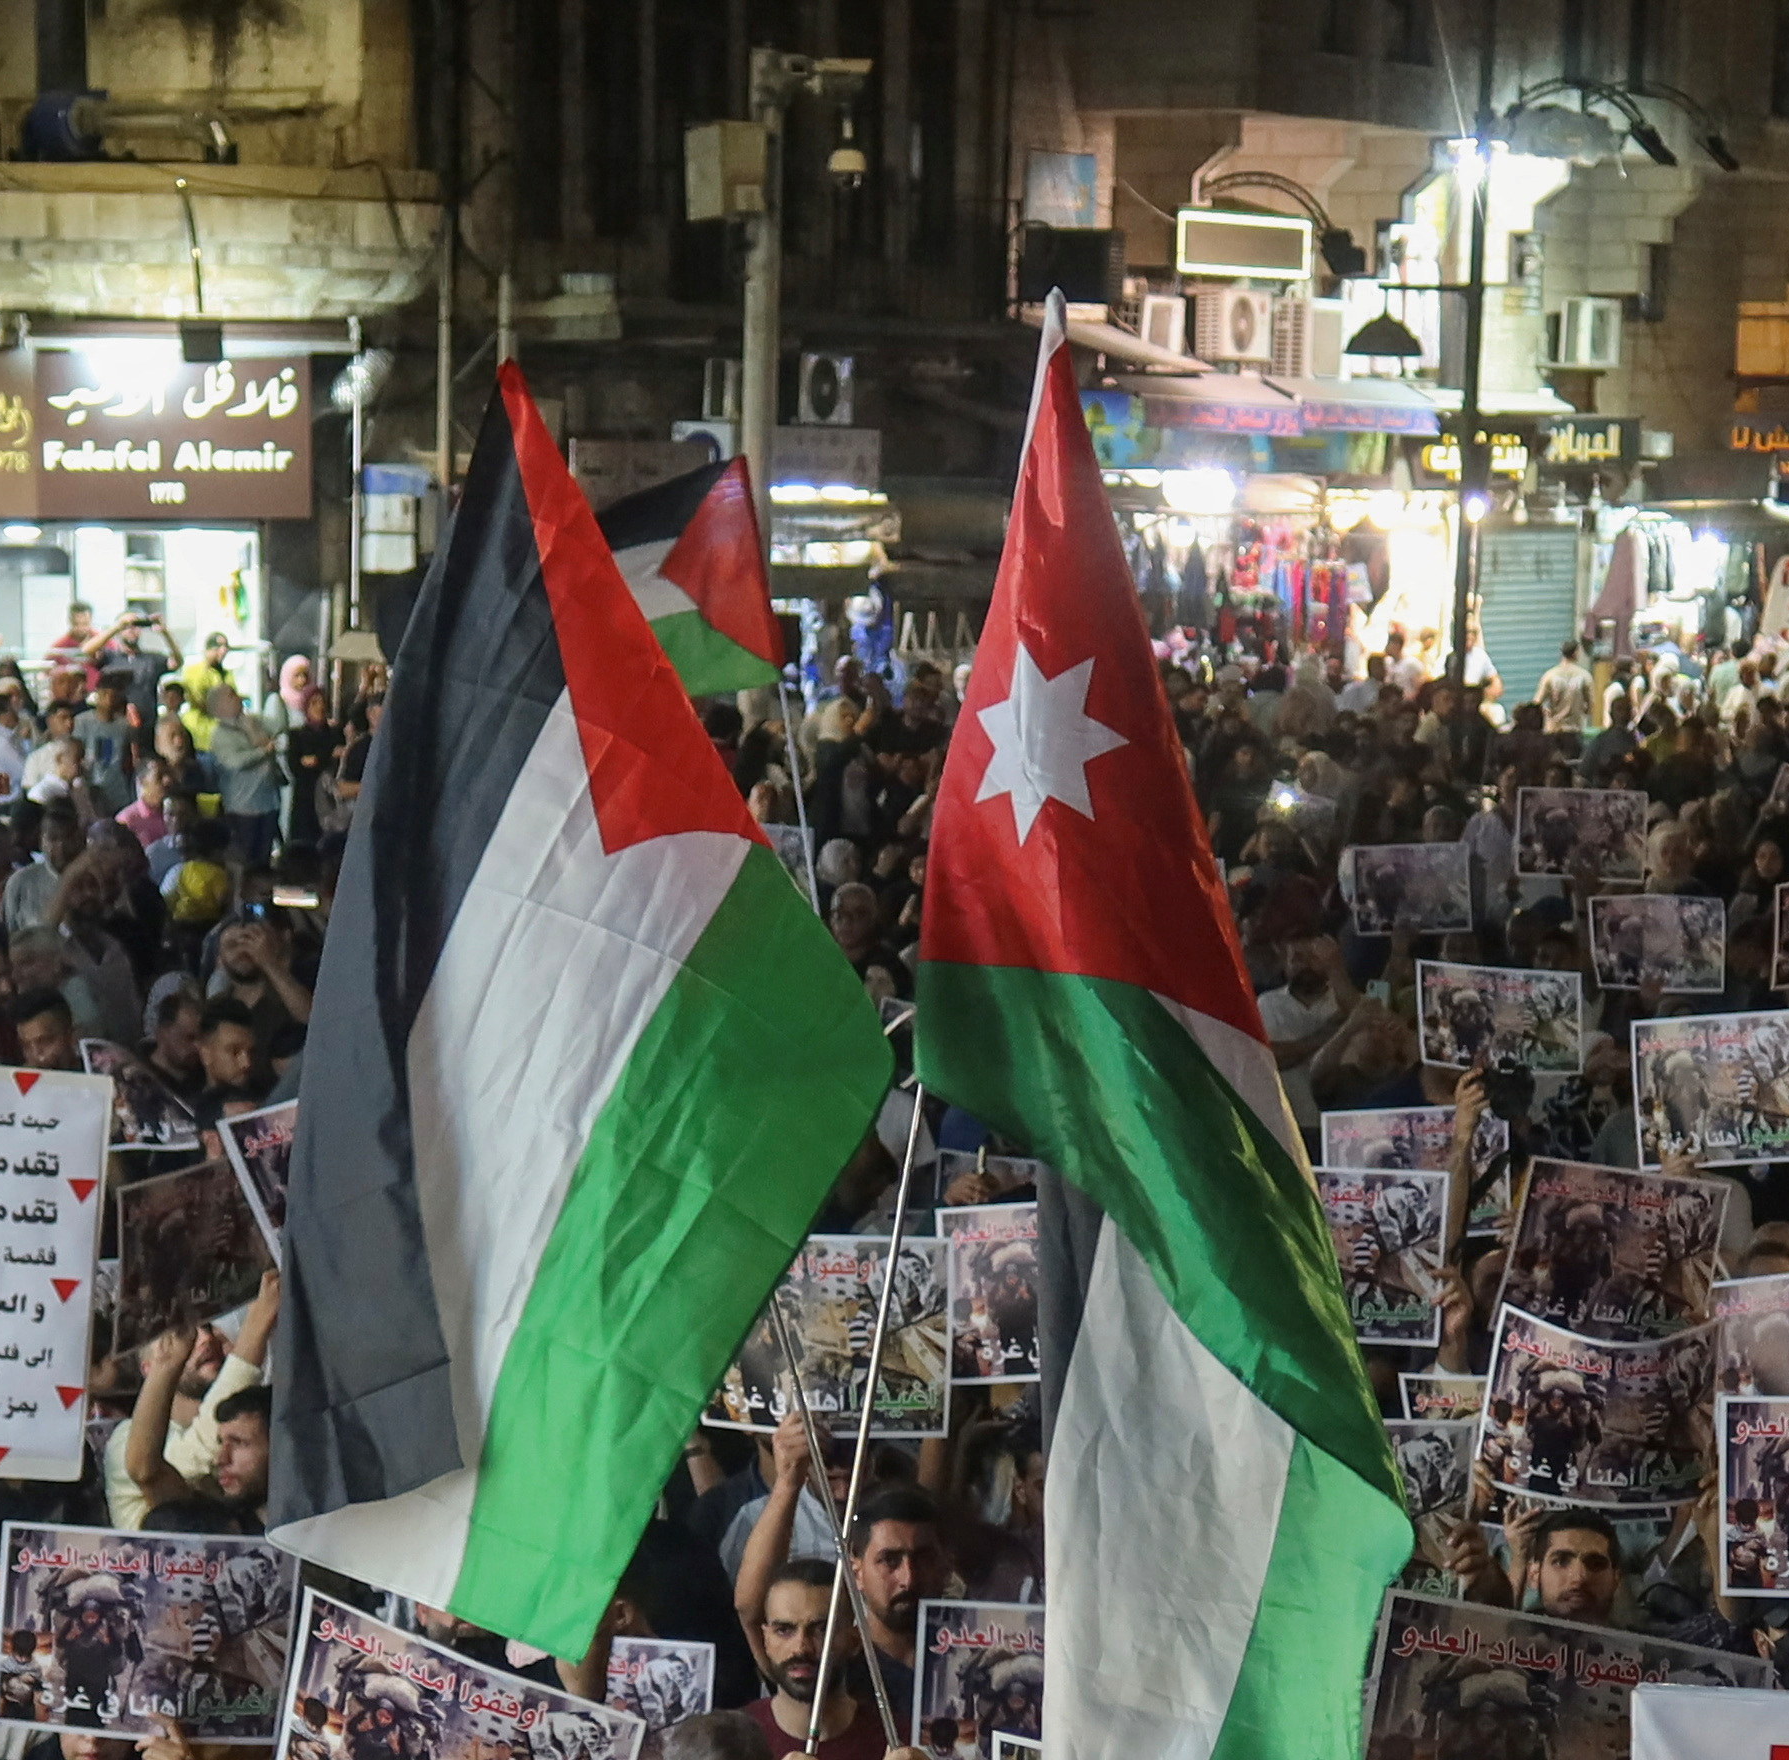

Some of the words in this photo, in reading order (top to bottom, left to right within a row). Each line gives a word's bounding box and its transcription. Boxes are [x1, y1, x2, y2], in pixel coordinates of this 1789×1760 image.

[182, 360, 299, 419] فلافل
[42, 440, 162, 472] Falafel
[173, 440, 294, 472] Alamir
[22, 1113, 61, 1133] حيث
[34, 1306, 45, 1323] و
[25, 1349, 53, 1369] إلى
[14, 1544, 84, 1574] العدو
[86, 1549, 149, 1577] إمداد
[153, 1548, 226, 1585] أوقفوا
[313, 1611, 386, 1660] العدو
[387, 1651, 457, 1700] إمداد
[40, 1677, 93, 1715] غزة
[458, 1677, 548, 1733] أوقفوا
